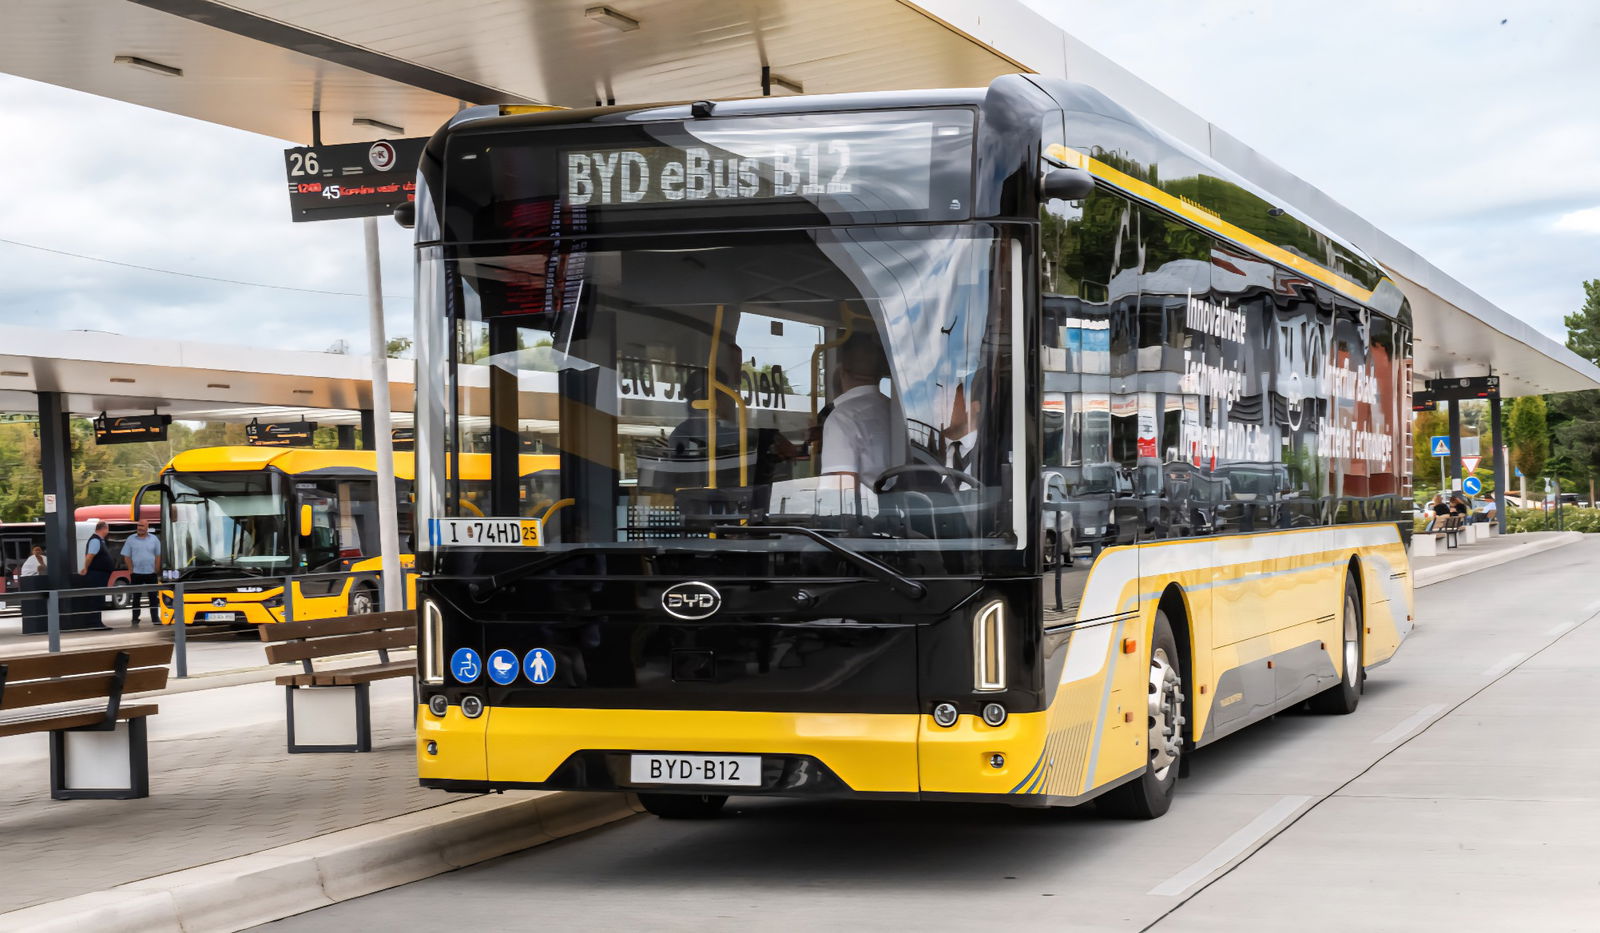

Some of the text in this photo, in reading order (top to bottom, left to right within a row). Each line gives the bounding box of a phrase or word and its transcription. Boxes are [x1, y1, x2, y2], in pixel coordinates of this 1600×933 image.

[289, 151, 319, 176] 26
[568, 139, 851, 205] BYD eBus B12
[322, 185, 340, 199] 45
[1186, 287, 1246, 344] Innovativste
[450, 522, 537, 543] I 74HD 25
[668, 593, 714, 608] BYD
[650, 758, 741, 781] BYD-B12
